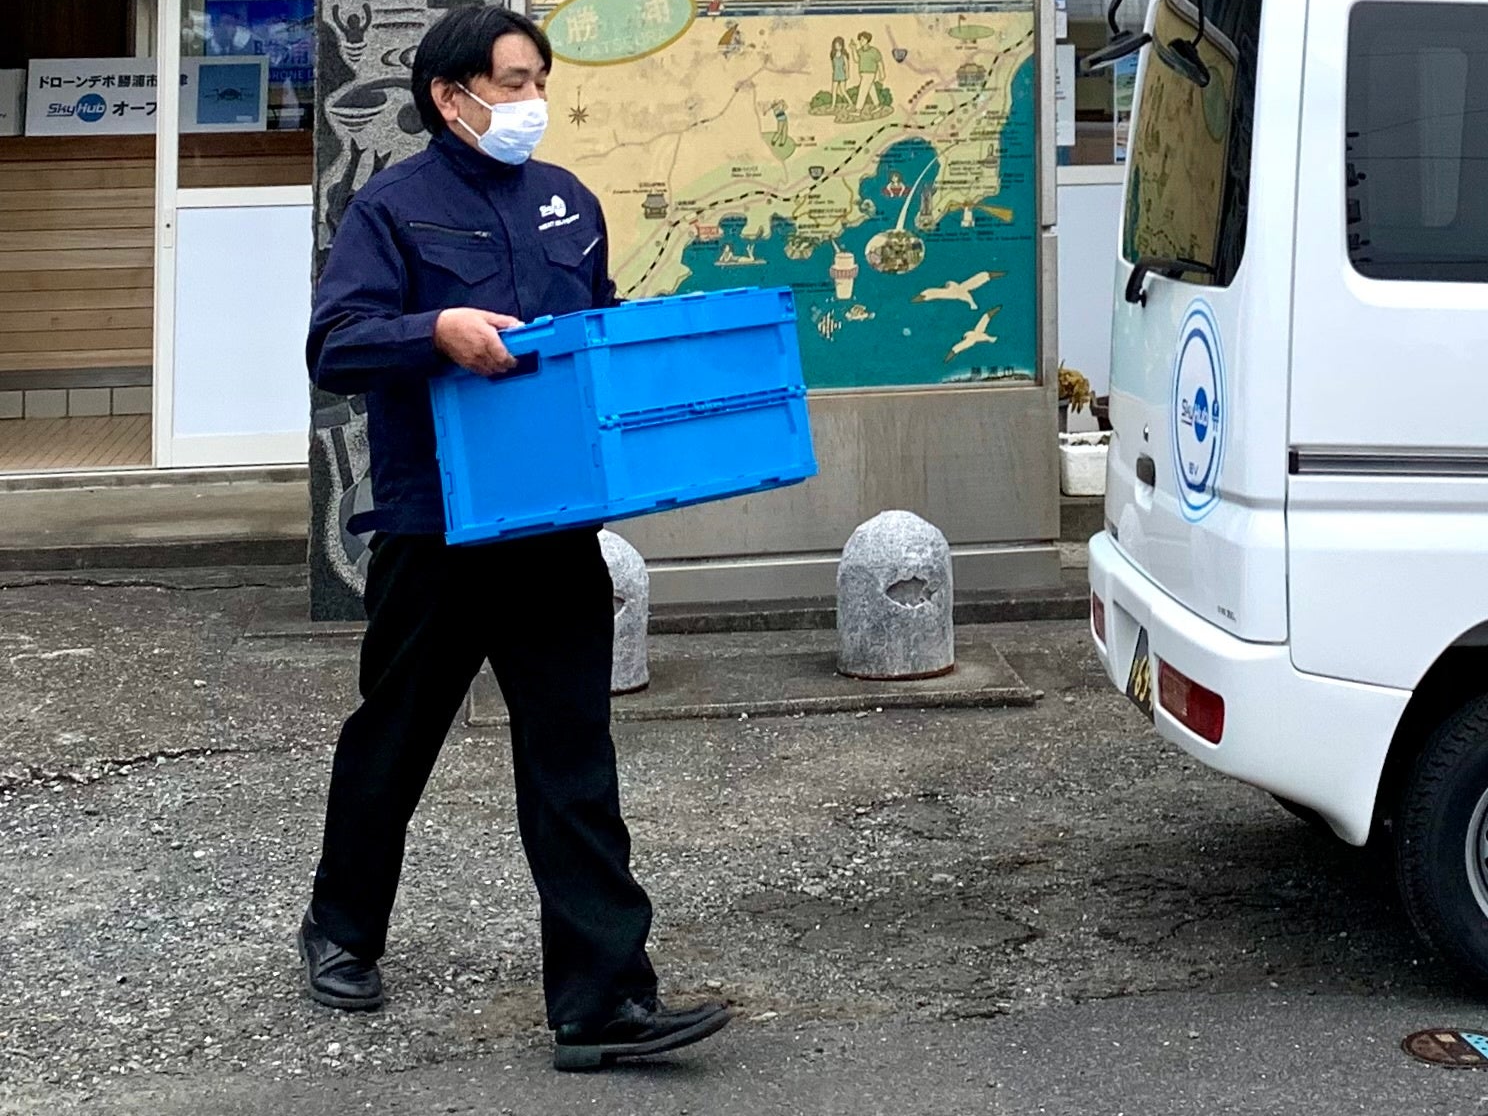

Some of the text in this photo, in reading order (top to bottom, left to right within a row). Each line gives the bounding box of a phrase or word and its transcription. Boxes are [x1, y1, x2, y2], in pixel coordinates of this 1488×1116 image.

[46, 101, 158, 118] SkyHub オープ
